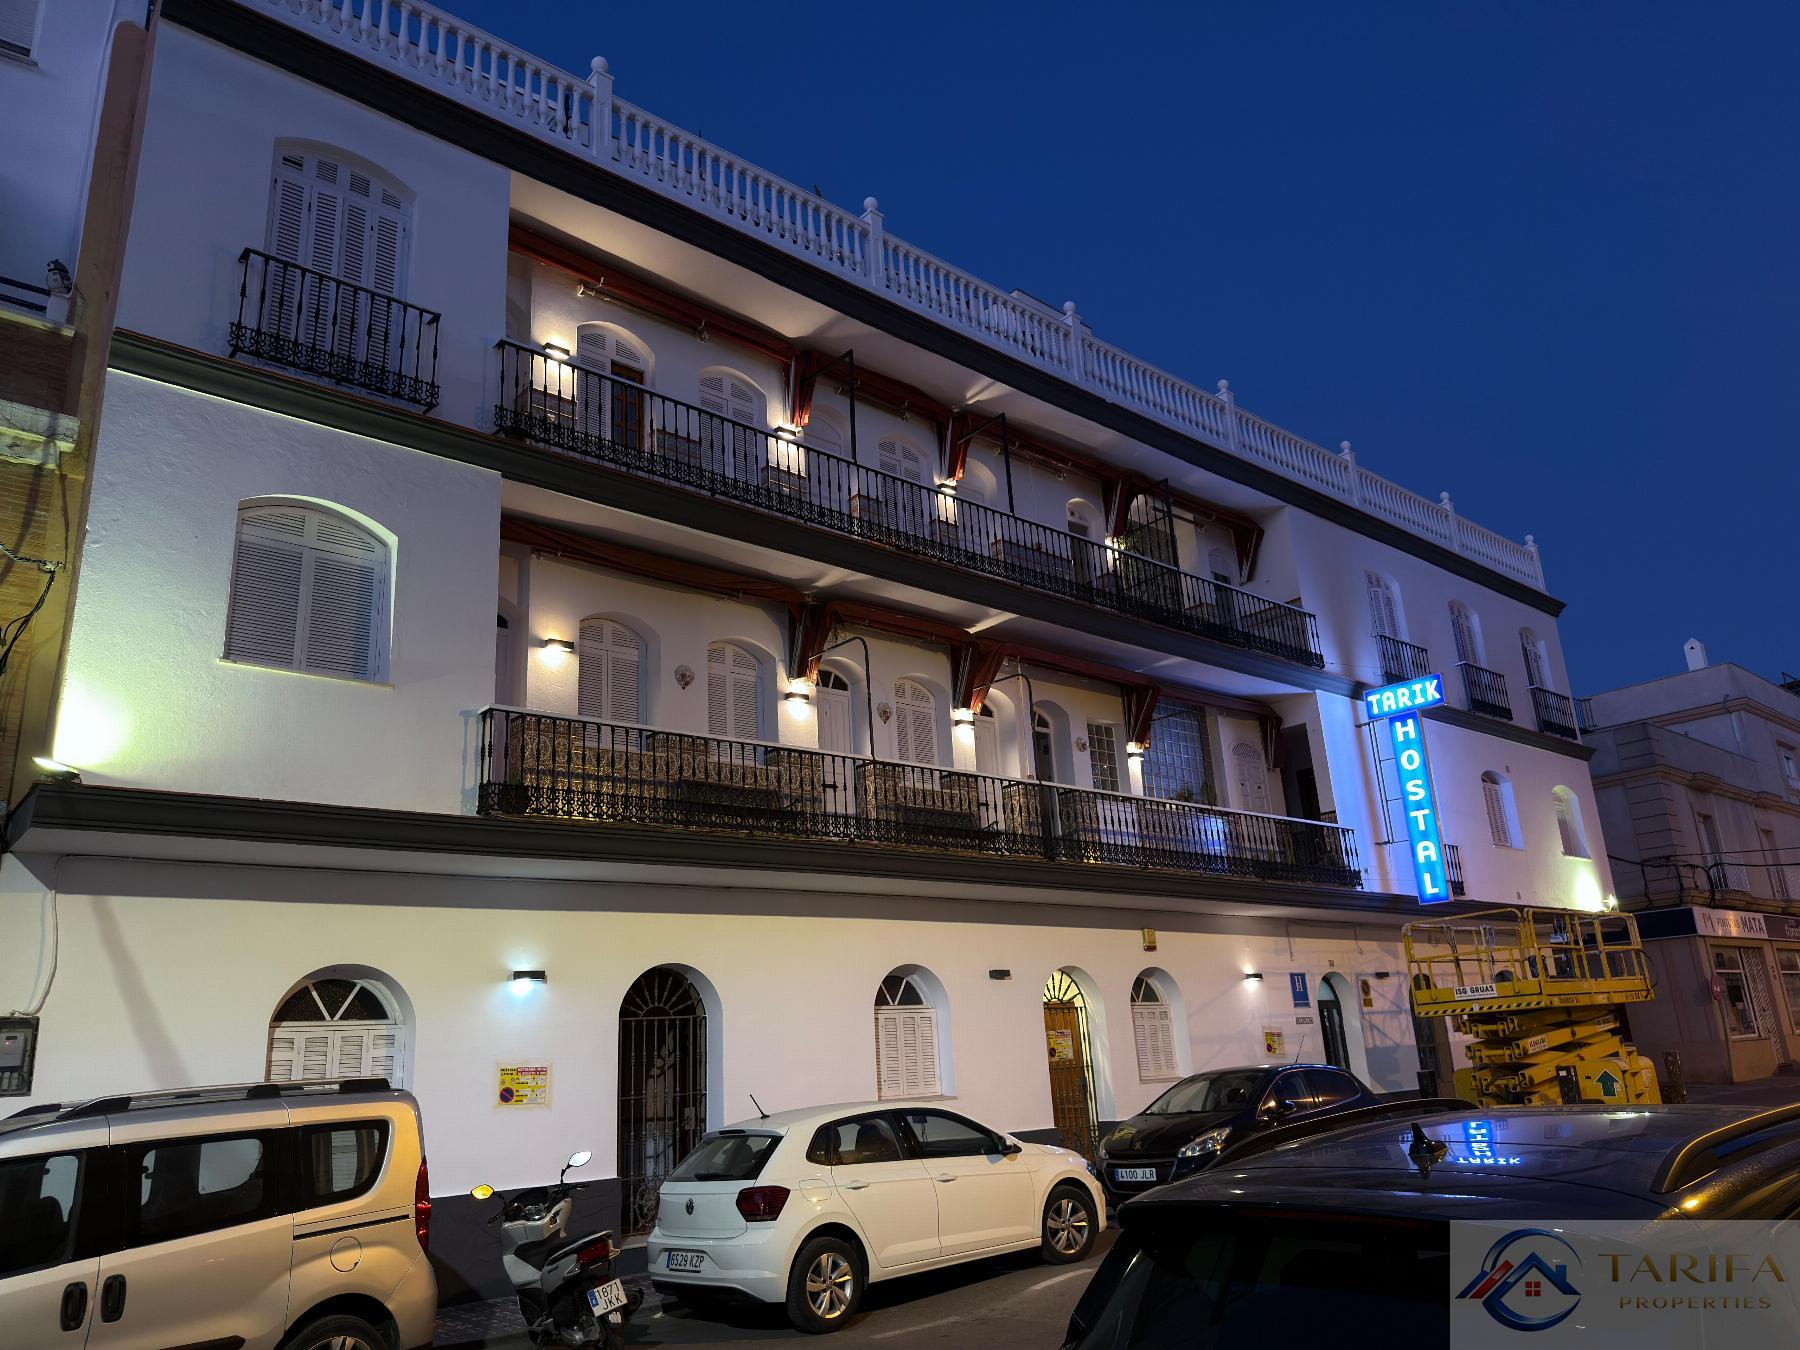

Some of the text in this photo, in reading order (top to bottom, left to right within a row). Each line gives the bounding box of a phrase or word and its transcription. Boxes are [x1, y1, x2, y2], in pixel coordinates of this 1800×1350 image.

[1367, 679, 1441, 715] TARIK
[1395, 718, 1440, 895] HOSTAL
[1740, 915, 1765, 934] MATA
[1470, 984, 1495, 994] GRUAS
[1120, 1169, 1155, 1180] 4100 JLR
[671, 1253, 705, 1269] 6529 KZP
[596, 1281, 620, 1300] 1871
[603, 1292, 623, 1311] JKK
